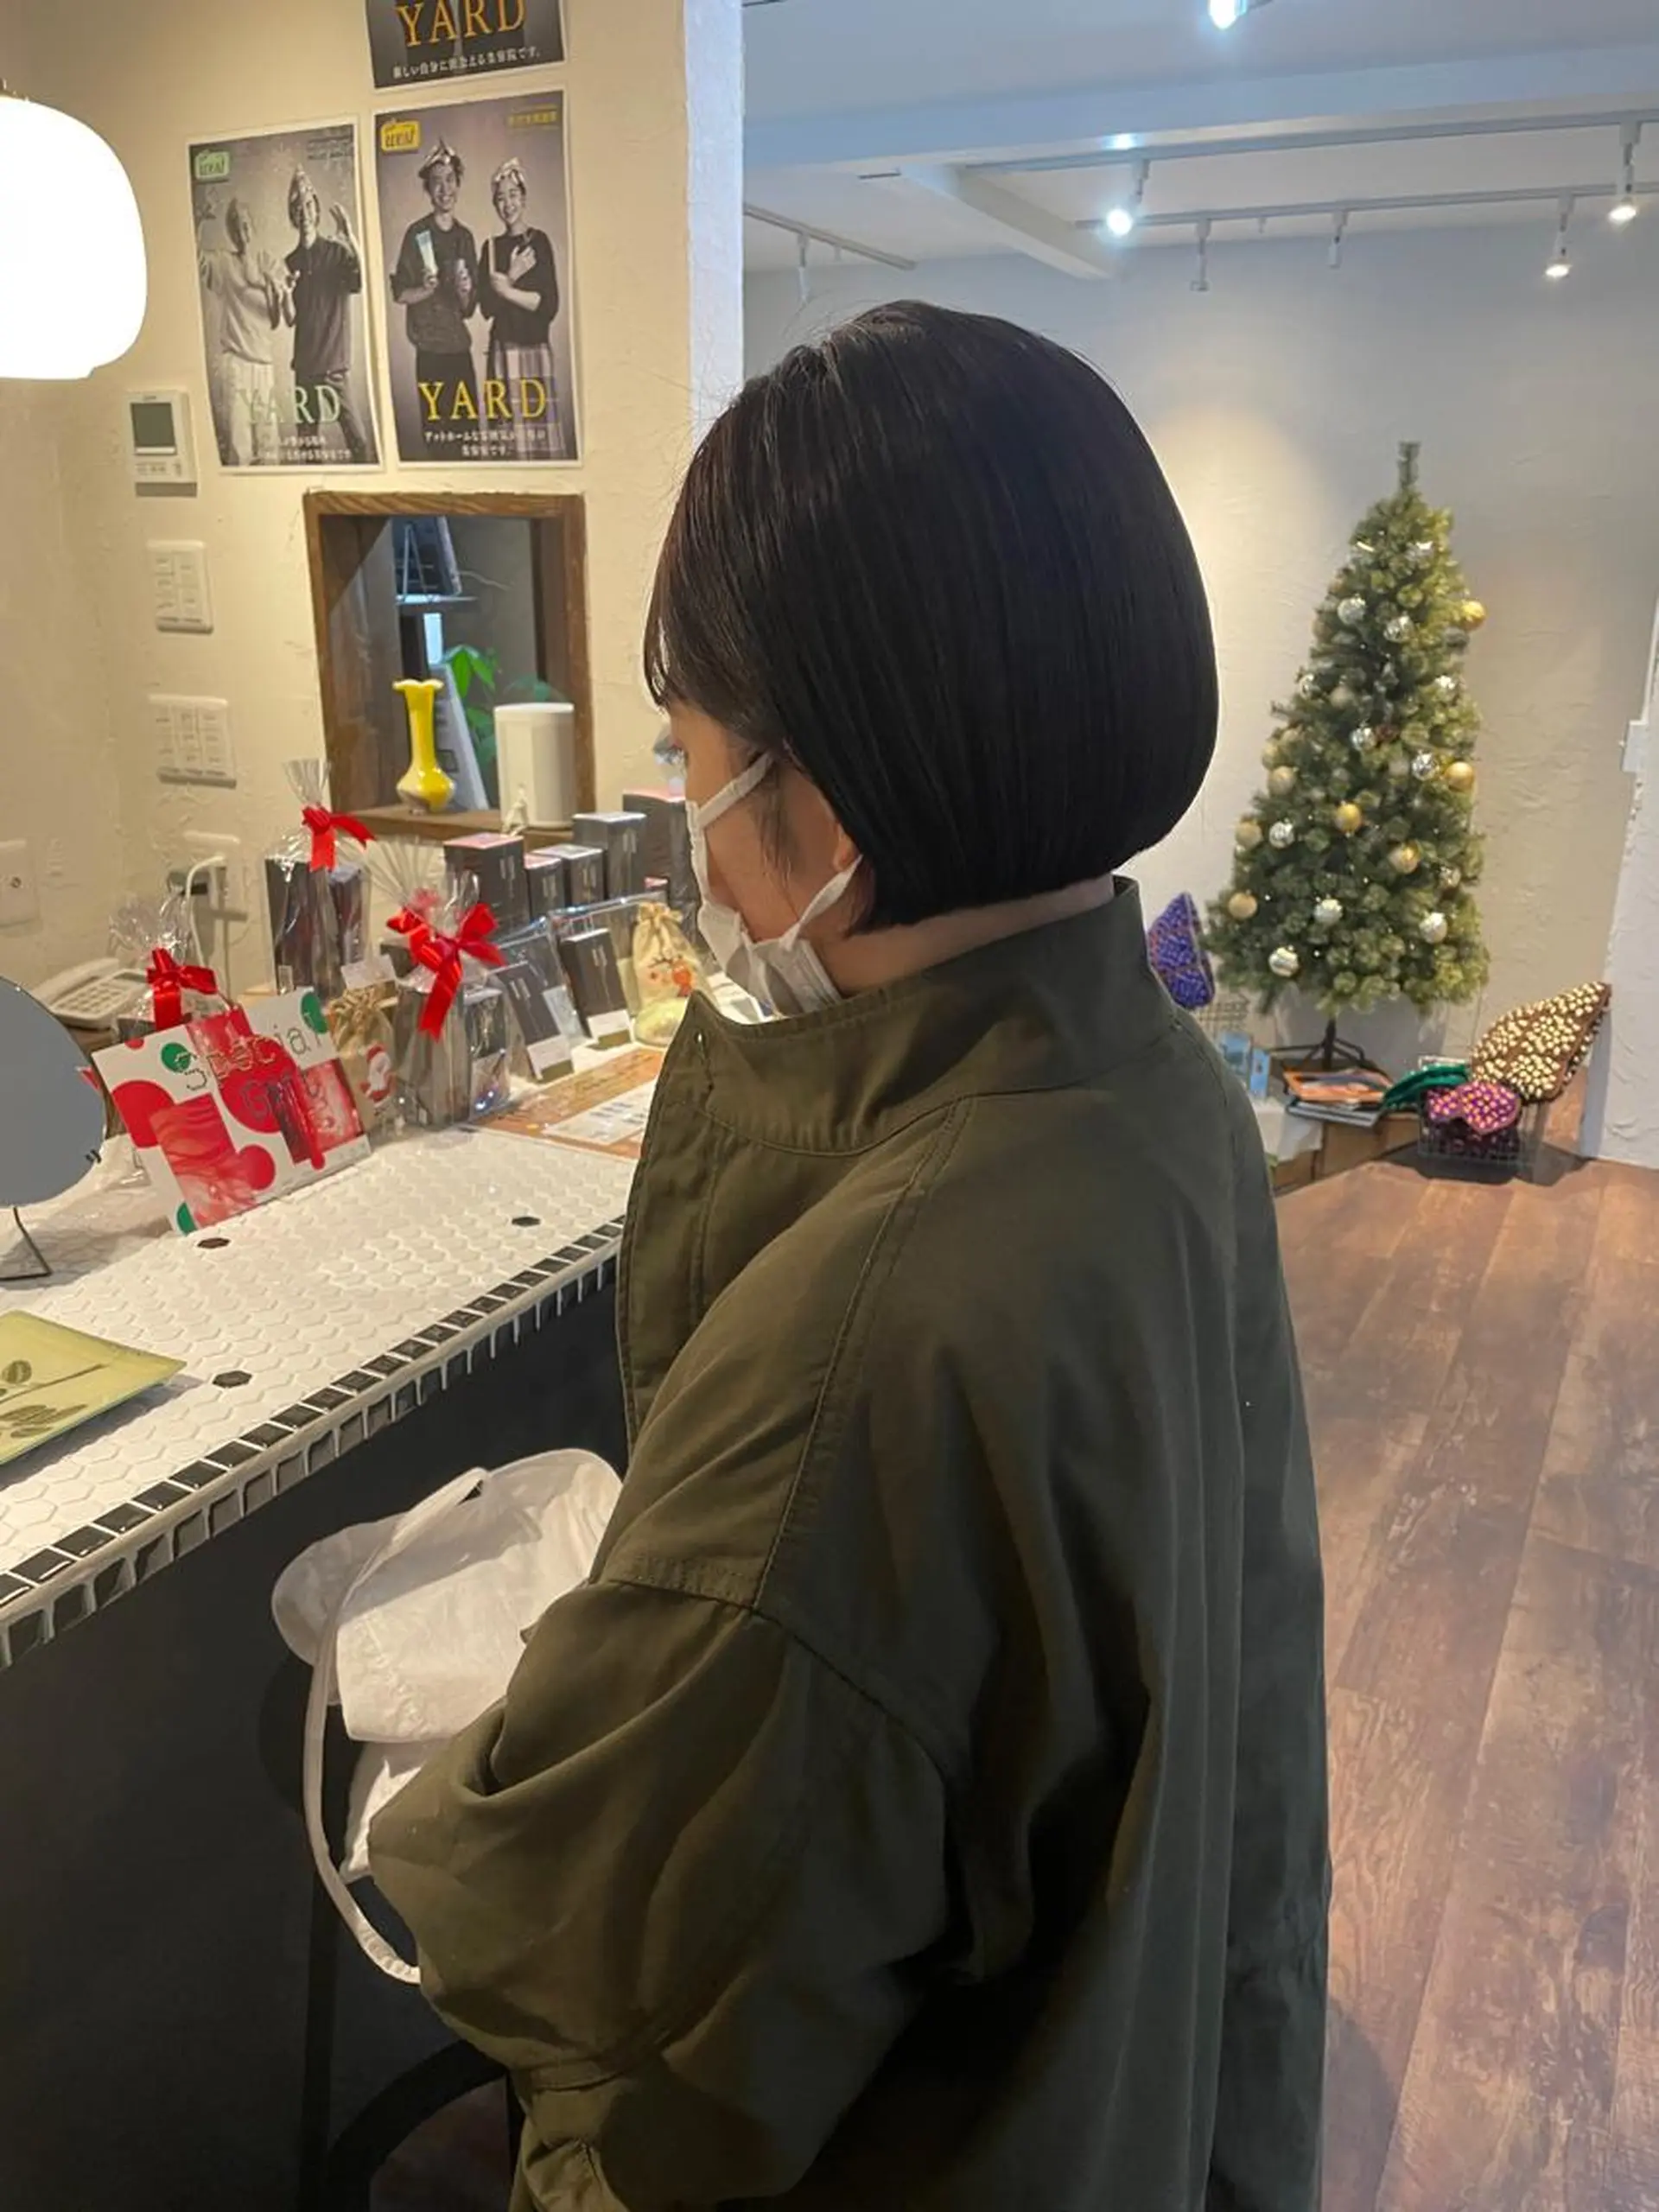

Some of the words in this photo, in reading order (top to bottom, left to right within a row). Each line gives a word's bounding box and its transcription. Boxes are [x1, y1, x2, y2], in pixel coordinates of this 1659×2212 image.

[395, 0, 526, 47] YARD
[235, 385, 341, 424] YARD
[417, 378, 547, 421] YARD
